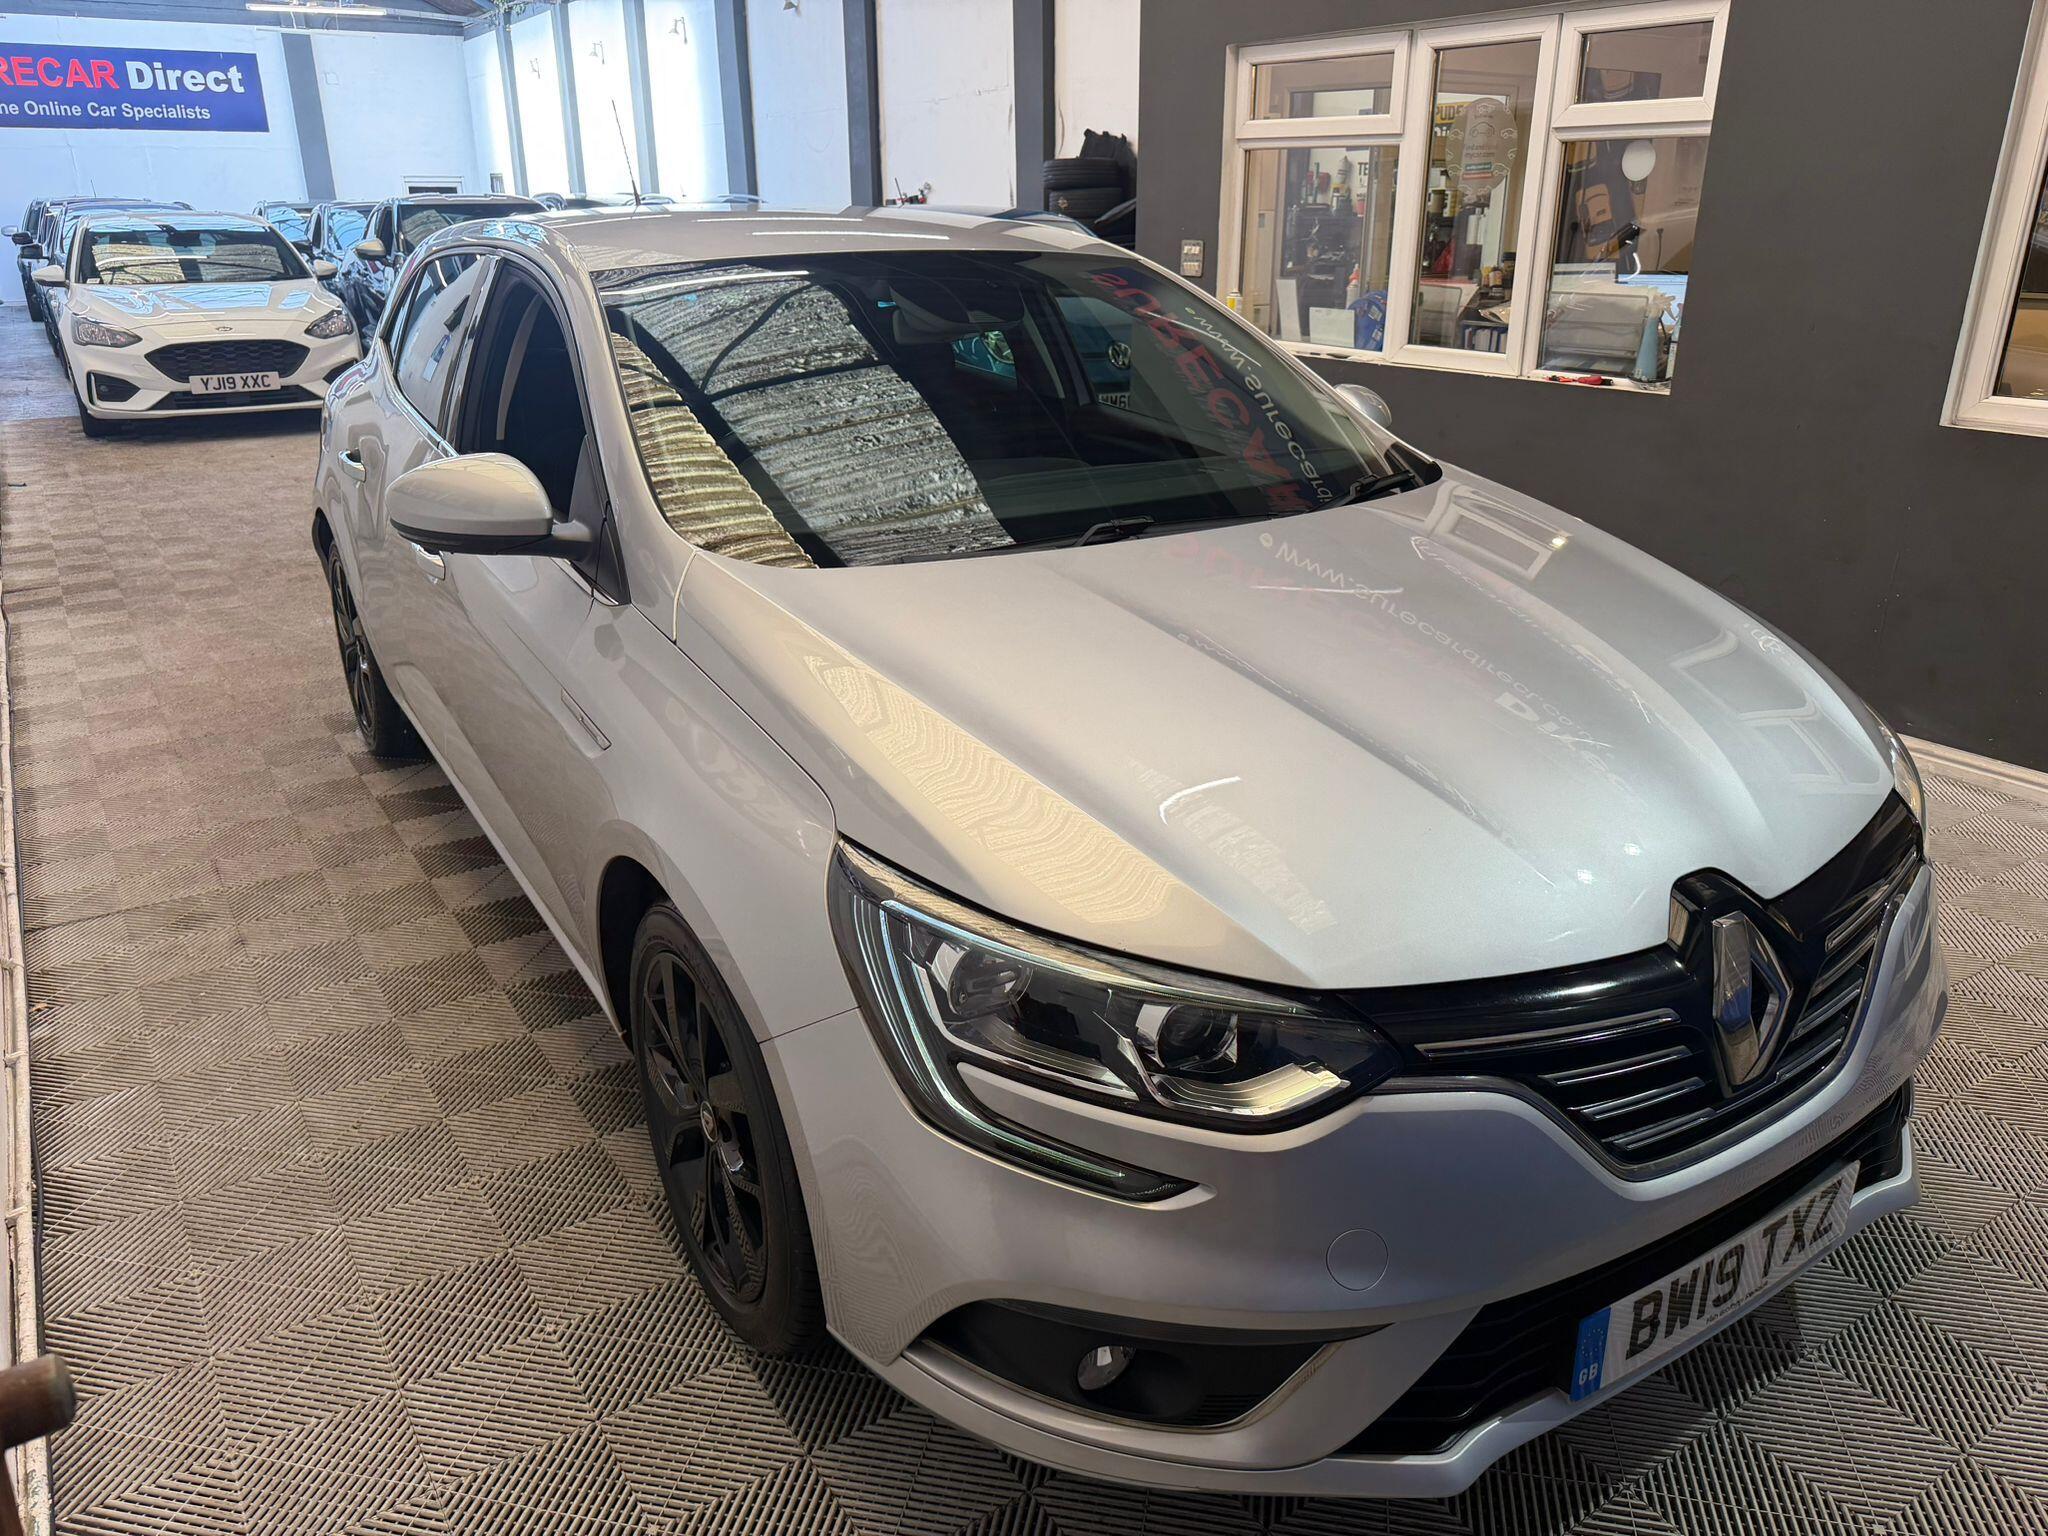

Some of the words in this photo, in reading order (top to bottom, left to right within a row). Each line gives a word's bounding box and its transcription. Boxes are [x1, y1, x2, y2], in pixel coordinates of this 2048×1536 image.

[126, 61, 245, 93] Direct
[24, 101, 81, 116] Online
[87, 102, 117, 117] Car
[122, 103, 211, 121] Specialists
[200, 376, 236, 391] YJ19
[240, 374, 271, 389] XXC
[1625, 1244, 1745, 1360] BW19
[1761, 1178, 1844, 1280] TXZ
[1578, 1362, 1599, 1387] GB
